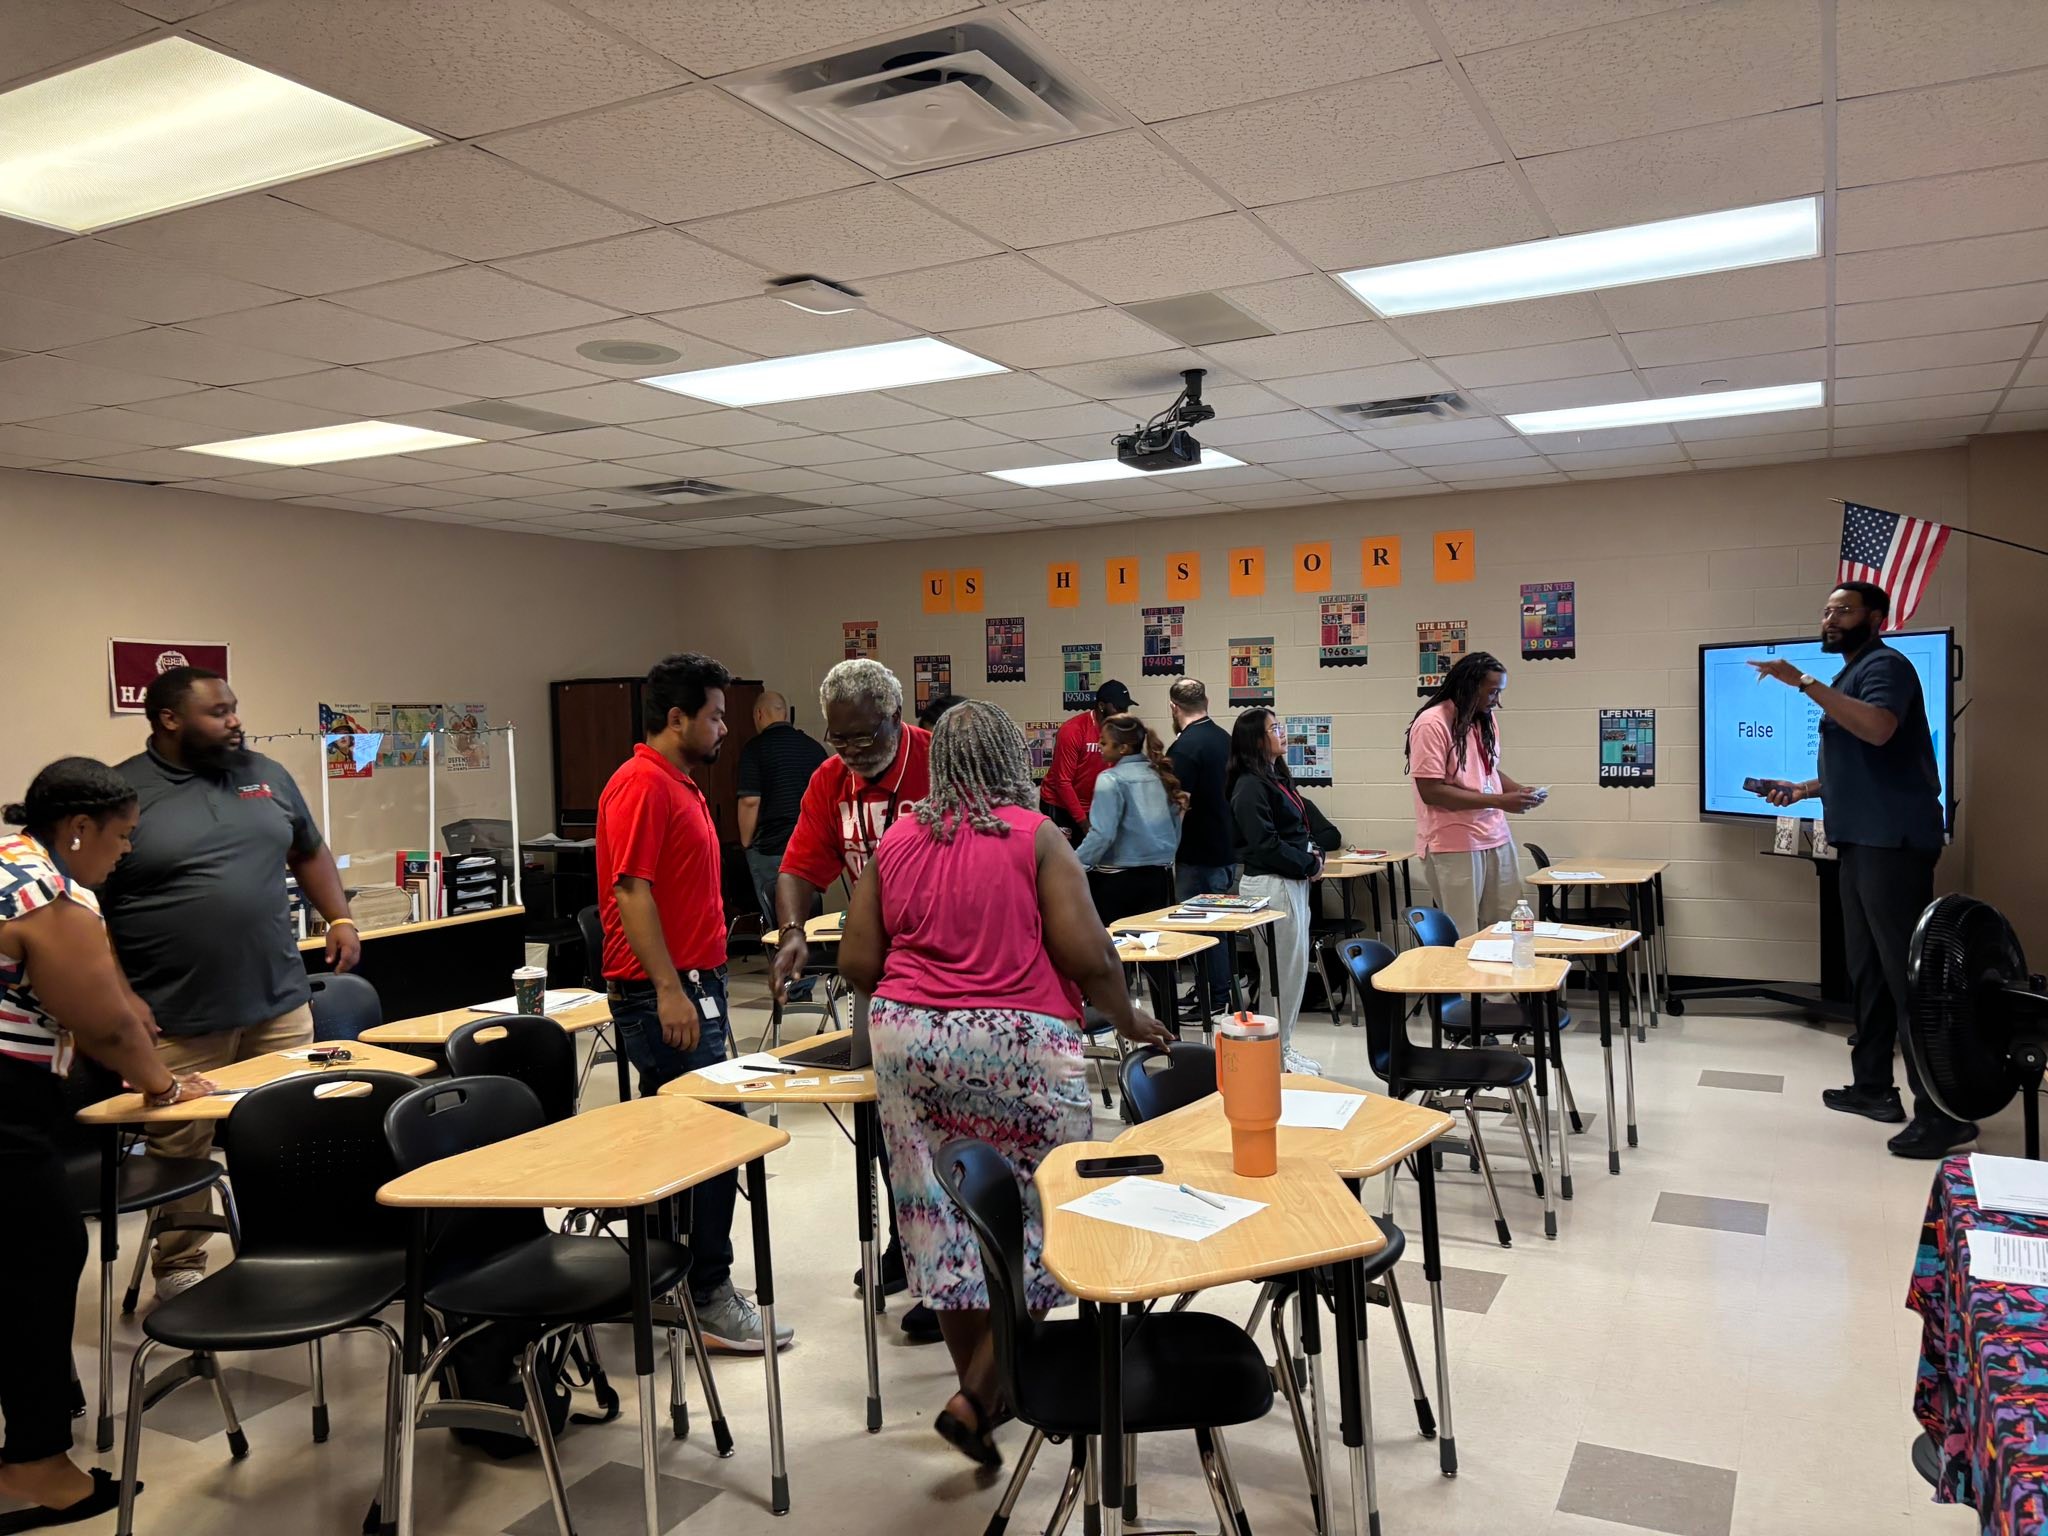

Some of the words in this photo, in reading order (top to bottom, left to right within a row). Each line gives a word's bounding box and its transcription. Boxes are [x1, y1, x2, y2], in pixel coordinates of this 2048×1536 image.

[1523, 585, 1542, 593] LIFE
[1554, 583, 1573, 591] THE
[1144, 608, 1159, 616] LIFE
[1170, 607, 1183, 615] THE
[1322, 647, 1354, 657] 1960s
[987, 664, 1014, 674] 1920s
[1418, 675, 1446, 686] 1970
[1065, 692, 1091, 702] 1930s
[1601, 710, 1622, 718] LIFE
[1622, 710, 1633, 718] IN
[1634, 709, 1654, 717] THE
[1738, 721, 1773, 738] False
[1086, 742, 1101, 752] TIT
